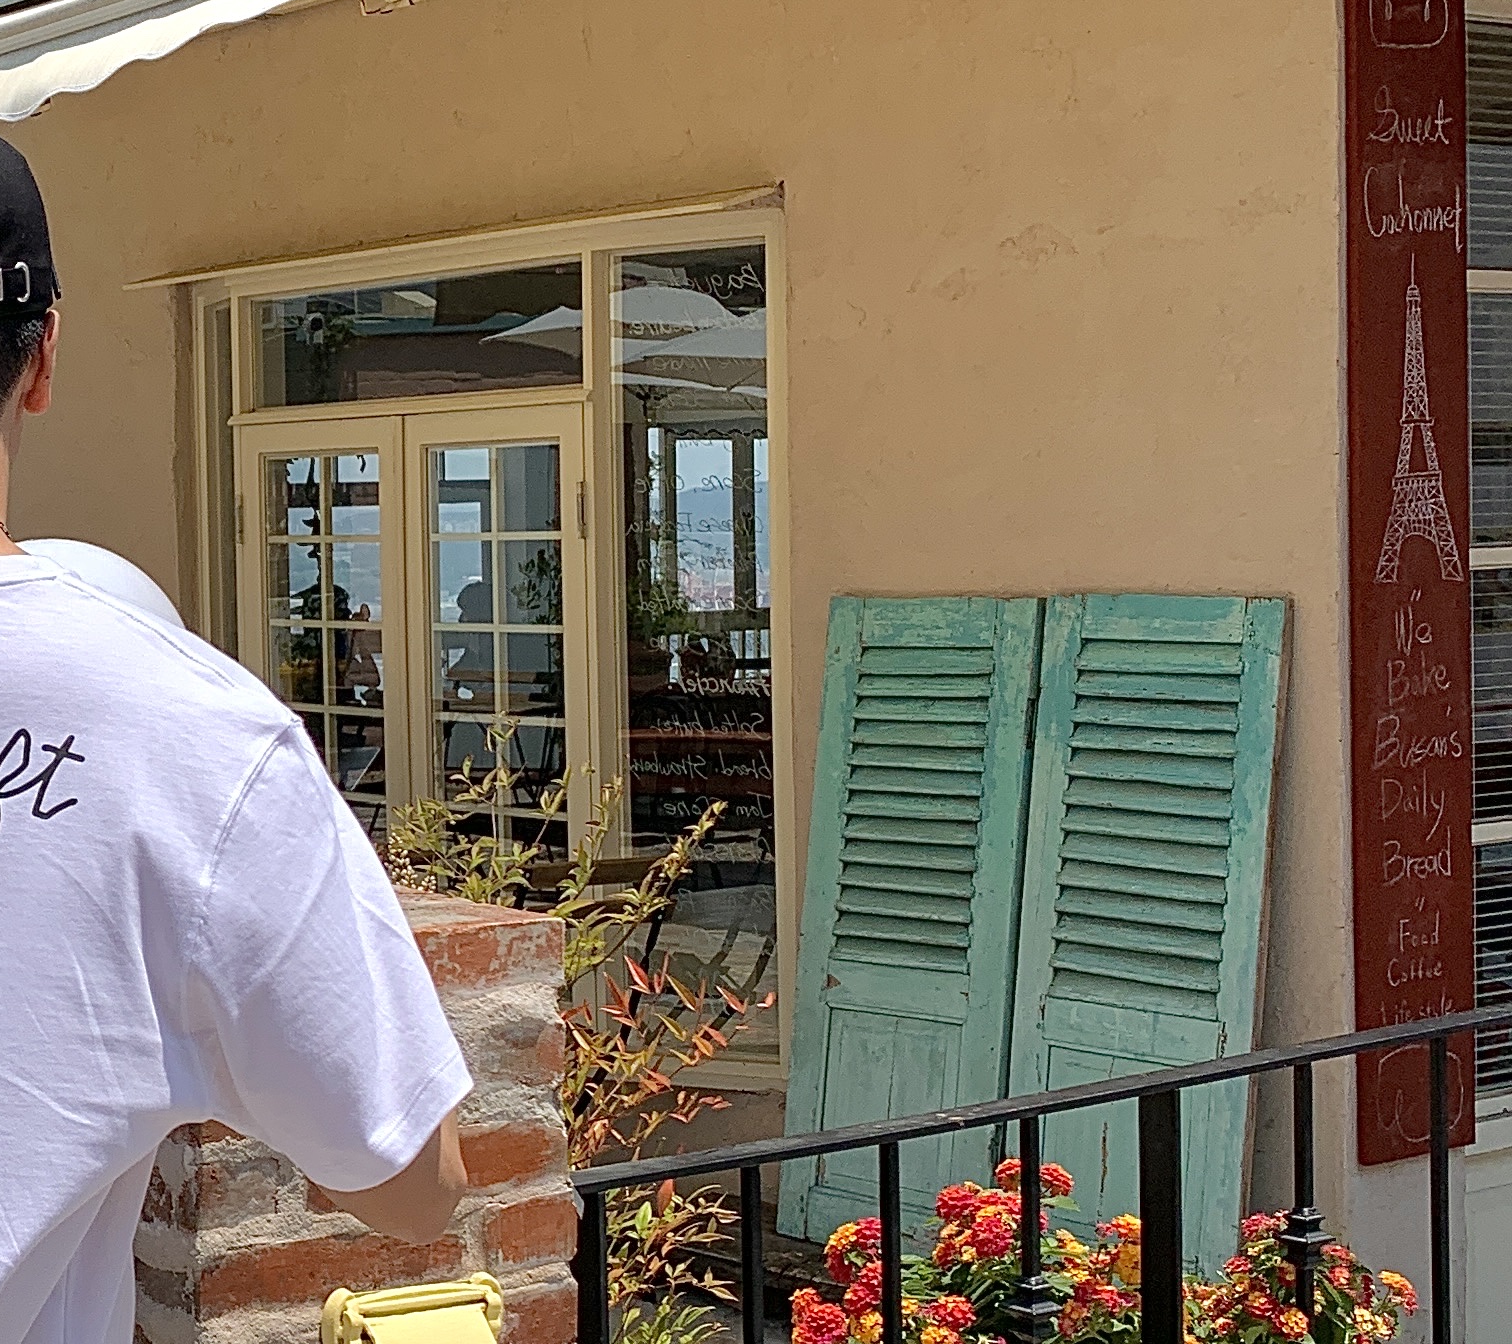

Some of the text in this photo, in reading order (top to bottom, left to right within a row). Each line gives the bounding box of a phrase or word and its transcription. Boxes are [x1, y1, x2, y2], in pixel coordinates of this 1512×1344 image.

[1394, 605, 1433, 657] We
[1387, 650, 1452, 707] Bake
[1381, 768, 1446, 842] Daily
[1382, 825, 1452, 887] Bread
[1399, 910, 1440, 953] Food
[1386, 956, 1443, 988] Coffee
